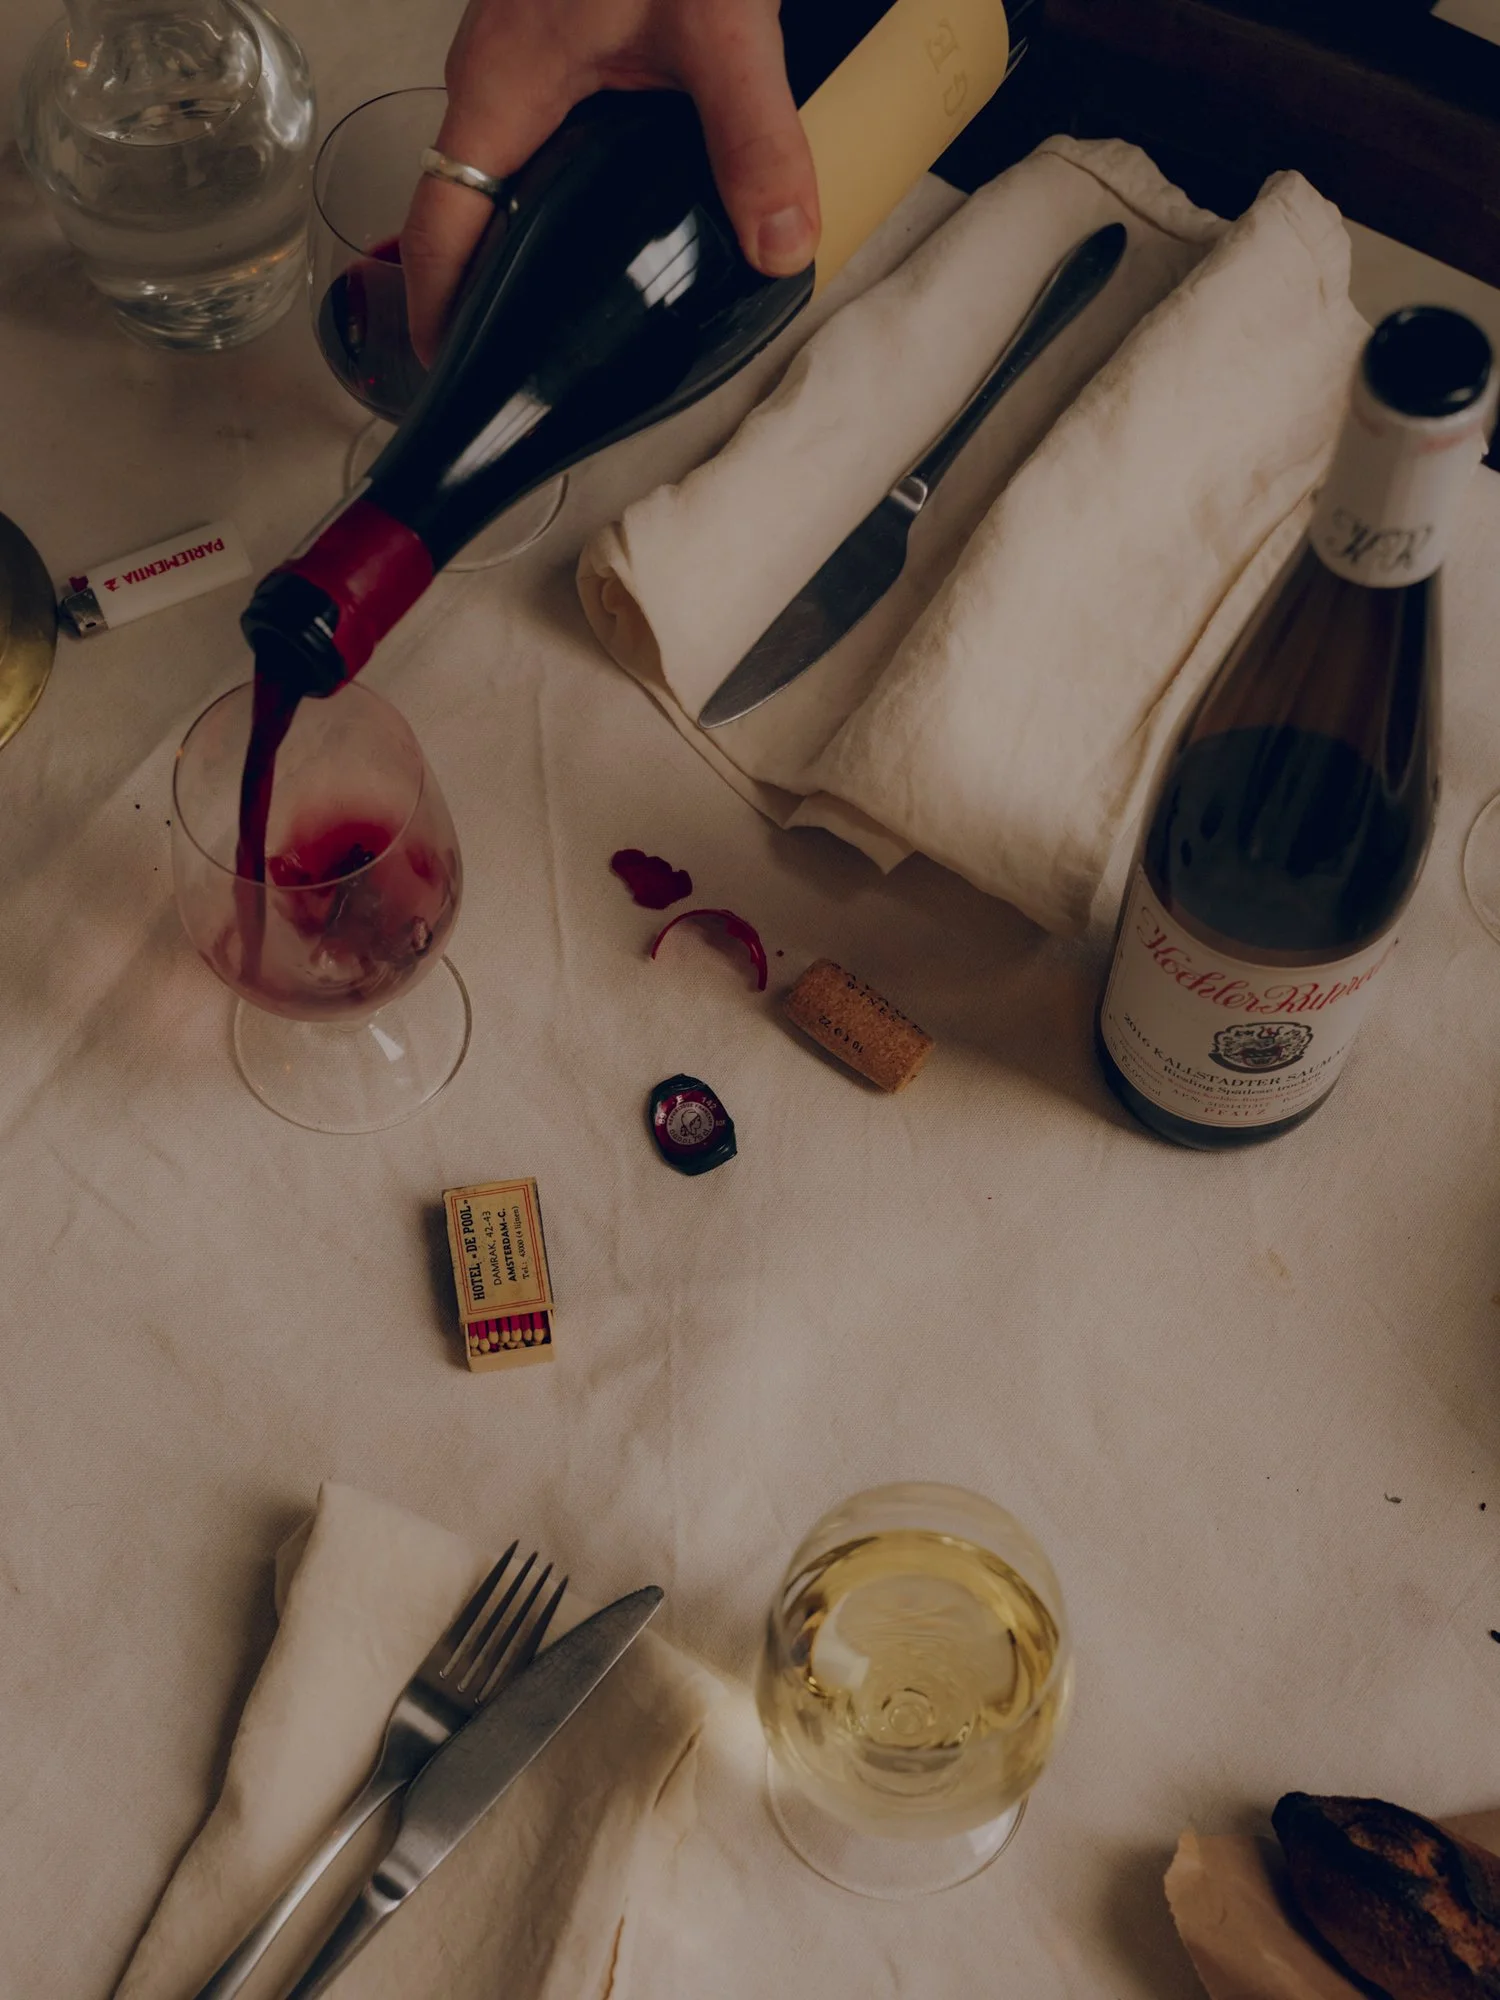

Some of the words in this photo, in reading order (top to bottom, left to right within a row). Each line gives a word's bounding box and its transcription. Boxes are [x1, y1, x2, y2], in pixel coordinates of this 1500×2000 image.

[122, 537, 225, 585] PARLEMENTIA
[1154, 1048, 1281, 1087] KALLSTADTER
[1163, 1064, 1214, 1092] Riesling
[482, 1210, 494, 1239] 42-43
[488, 1240, 503, 1286] DAMRAK,
[497, 1208, 517, 1282] AMSTERDAM-C.
[468, 1263, 486, 1301] HOTEL
